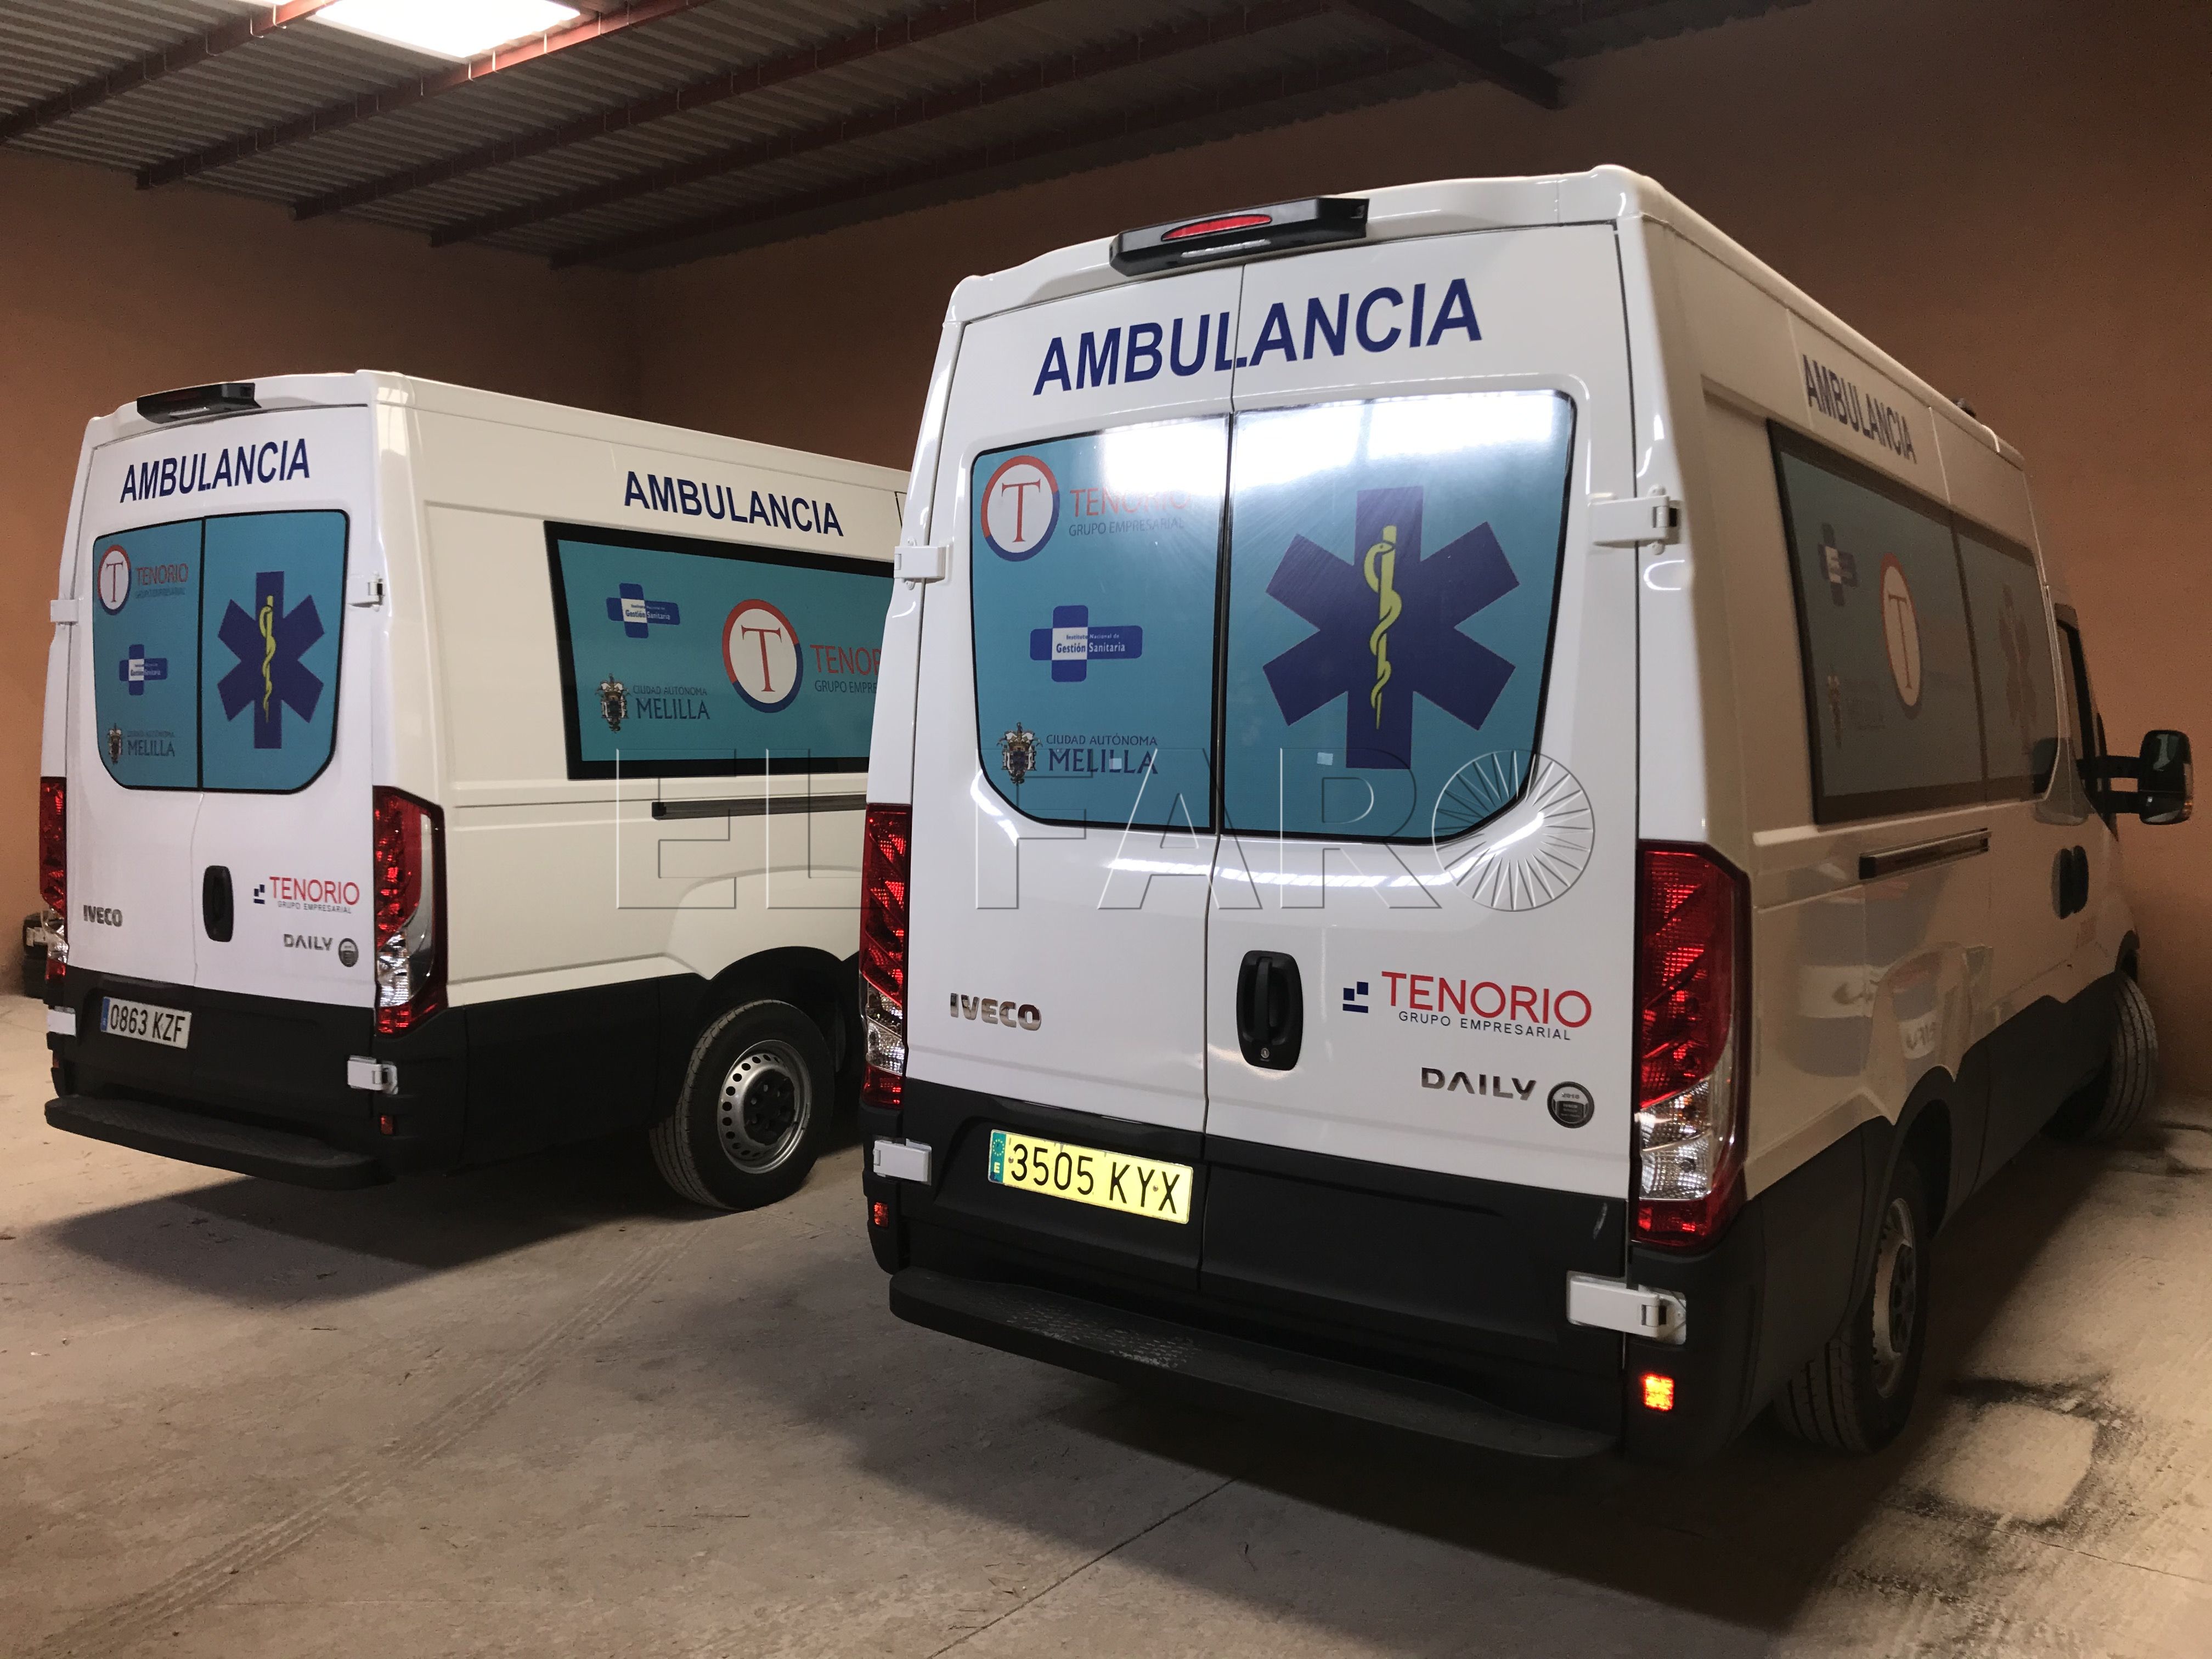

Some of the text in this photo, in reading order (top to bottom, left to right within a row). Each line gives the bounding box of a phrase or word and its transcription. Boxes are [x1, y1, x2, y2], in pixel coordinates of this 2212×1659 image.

[1032, 278, 1482, 396] AMBULANCIA
[1803, 354, 1918, 464] AMBULANCIA
[120, 438, 310, 503] AMBULANCIA
[624, 471, 844, 537] AMBULANCIA
[1001, 478, 1041, 543] T
[1069, 517, 1184, 537] GRUPO EMPRESARIAL
[106, 561, 124, 603] T
[136, 562, 189, 586] TENORIO
[741, 624, 782, 692] T
[1056, 642, 1125, 653] Gestión Sanitaria
[633, 685, 661, 695] CIUDAD
[815, 680, 847, 693] GRUPO
[635, 698, 710, 720] MELILLA
[127, 740, 176, 757] MELILLA
[1046, 733, 1158, 746] CIUDAD AUTÓNOMA
[1048, 748, 1158, 775] MELILLA
[269, 876, 360, 905] TENORIO
[83, 905, 123, 927] IVECO
[284, 934, 334, 951] DAILY
[950, 992, 1042, 1031] IVECO
[1381, 970, 1592, 1028] TENORIO
[110, 1004, 185, 1042] 0863 KZF
[1398, 1011, 1571, 1041] GRUPO EMPRESARIAL
[1421, 1066, 1537, 1101] DAILY
[994, 1161, 1001, 1173] E
[1011, 1143, 1180, 1214] 3505 KYX
